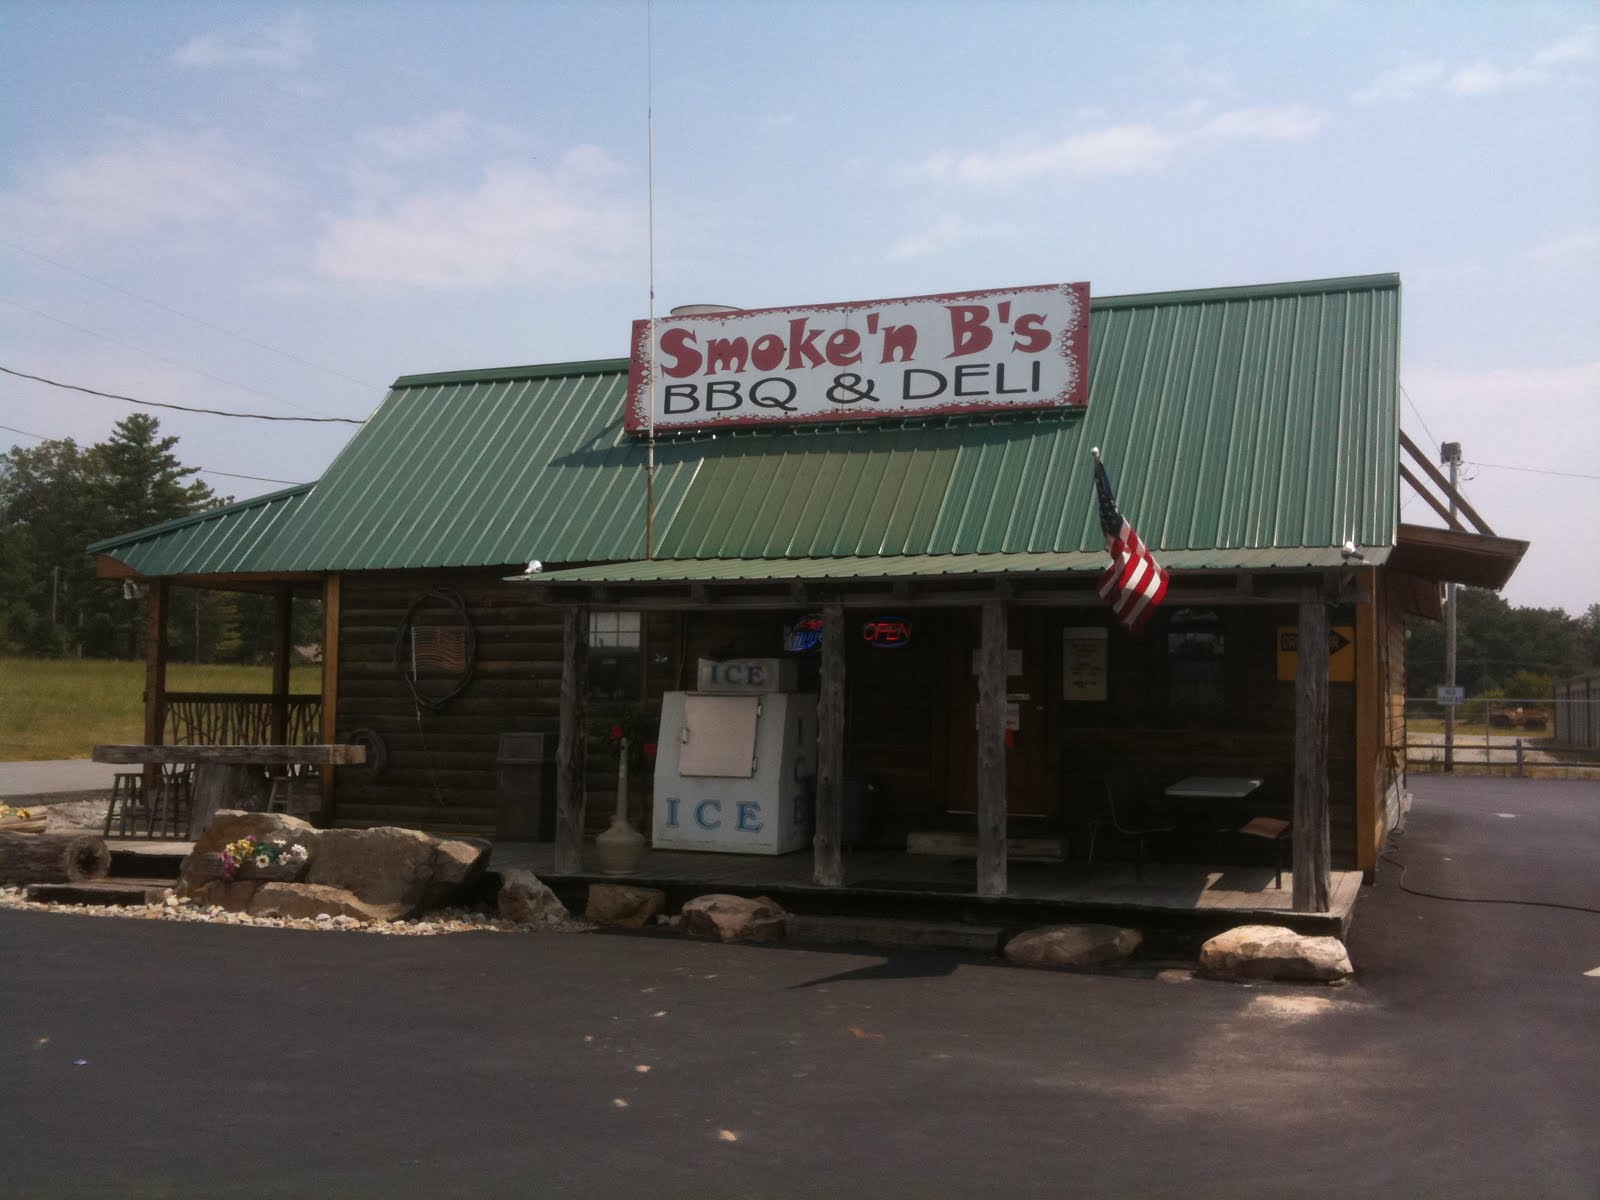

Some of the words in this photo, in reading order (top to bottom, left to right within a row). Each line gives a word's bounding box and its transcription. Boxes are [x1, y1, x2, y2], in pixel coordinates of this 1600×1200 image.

[660, 312, 918, 378] Smoke'n
[944, 301, 1052, 359] B's
[663, 377, 799, 415] BBQ
[825, 373, 880, 404] &
[902, 360, 1041, 400] DELI
[863, 622, 912, 641] OPEN
[709, 664, 764, 686] ICE
[666, 798, 764, 833] ICE
